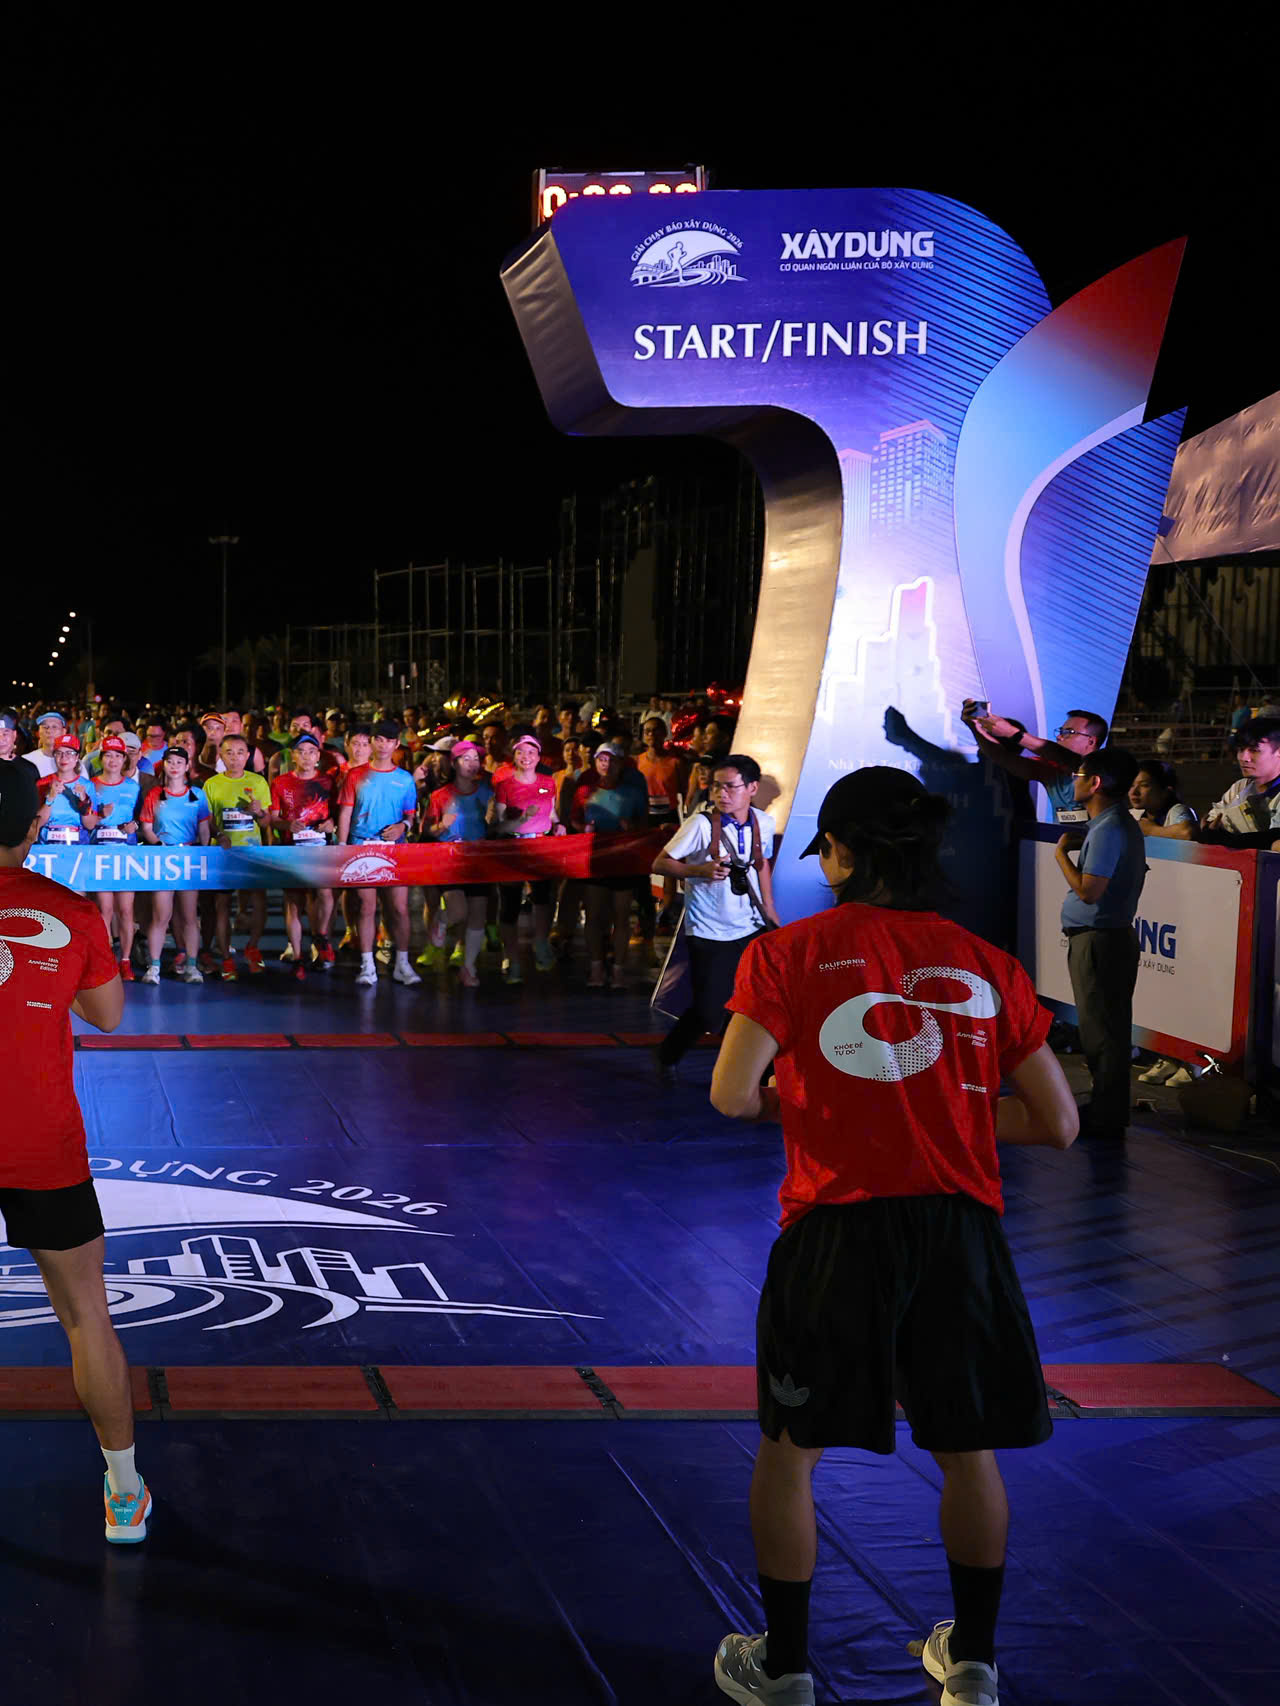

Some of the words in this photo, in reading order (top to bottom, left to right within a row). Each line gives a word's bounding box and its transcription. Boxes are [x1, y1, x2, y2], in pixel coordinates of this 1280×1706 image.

[665, 221, 683, 233] BÁO
[684, 218, 701, 229] XÂY
[727, 233, 744, 249] 2026
[792, 263, 815, 273] QUAN
[817, 261, 839, 271] NGÔN
[894, 260, 909, 269] XÂY
[634, 320, 928, 363] START/FINISH
[95, 854, 207, 881] FINISH
[28, 960, 58, 969] Anniversary
[819, 958, 866, 970] CALIFORNIA
[289, 1179, 448, 1216] 2026
